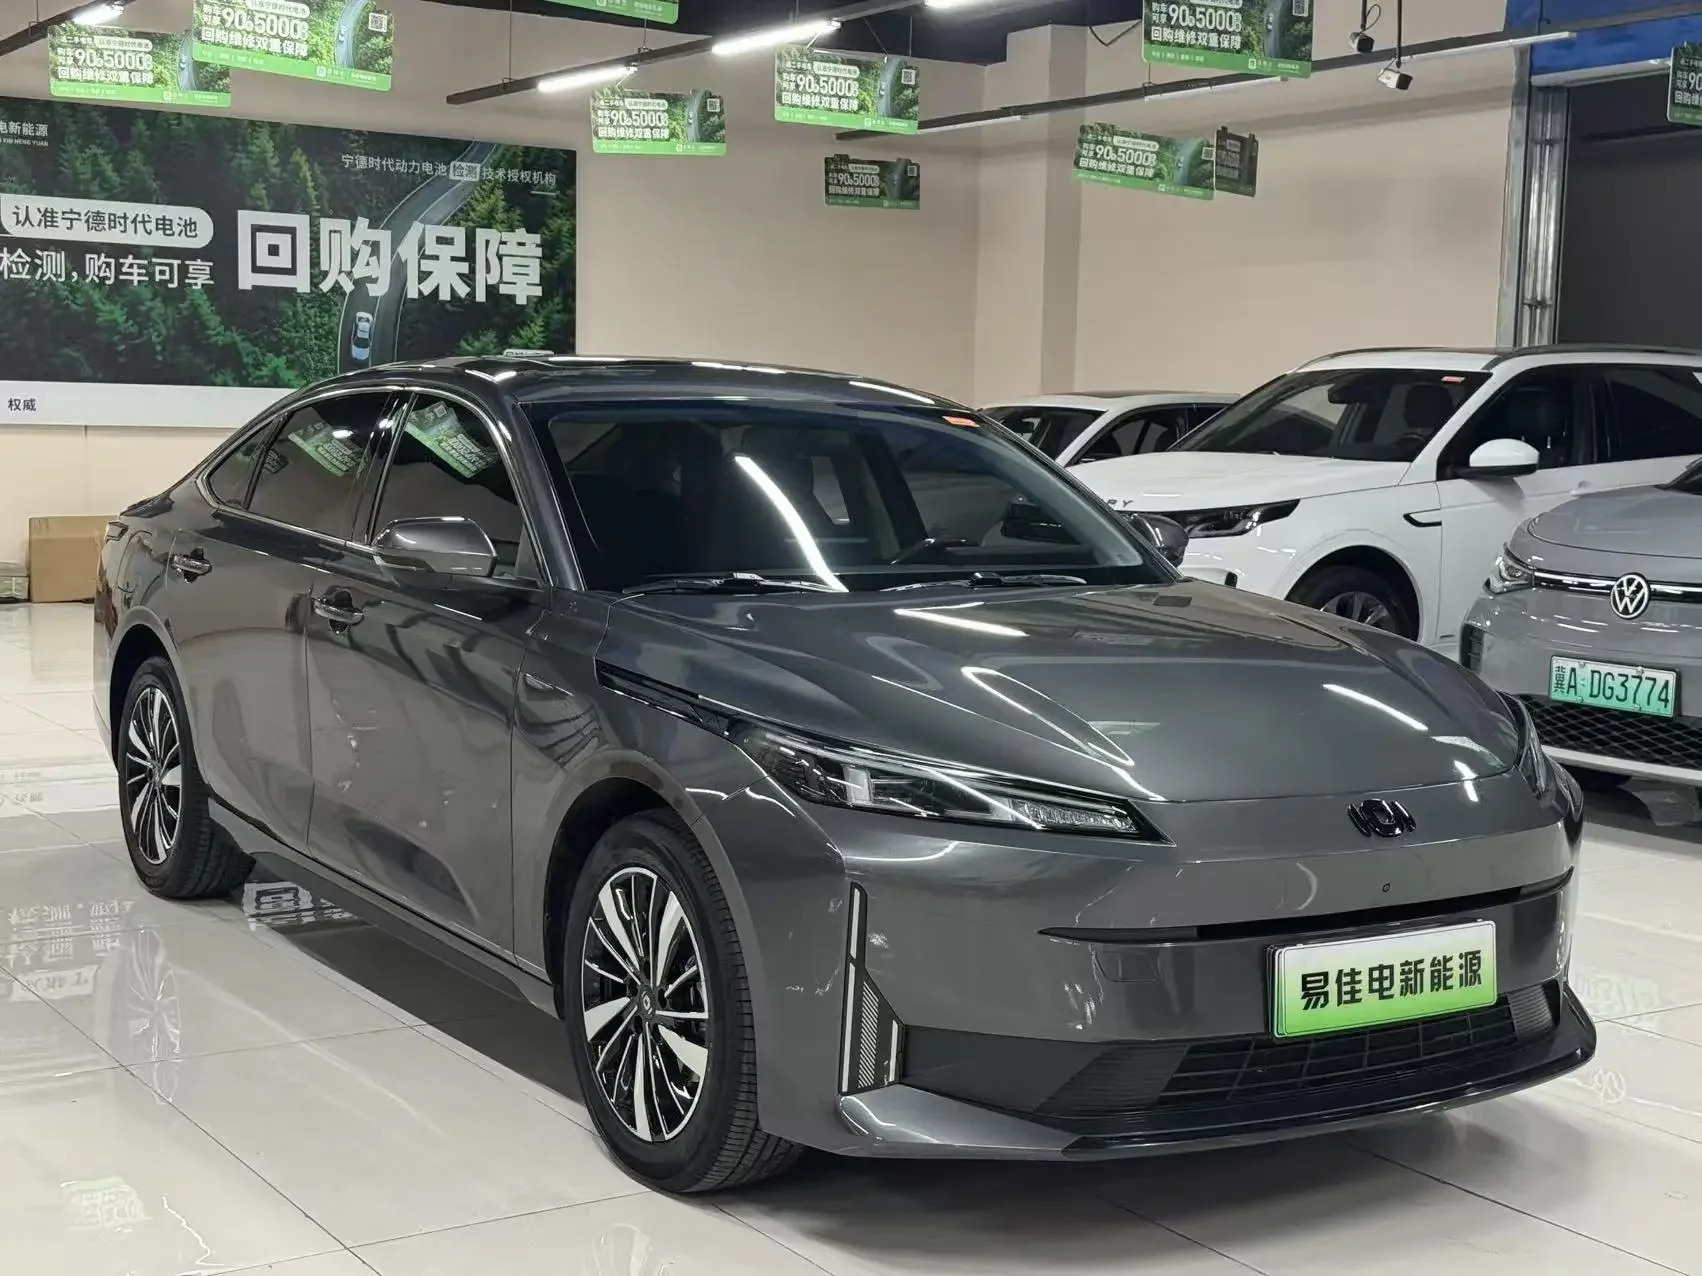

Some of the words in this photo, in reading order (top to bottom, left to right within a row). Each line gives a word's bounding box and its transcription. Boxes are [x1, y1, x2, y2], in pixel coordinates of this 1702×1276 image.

[201, 26, 309, 57] 回购维修双重保障
[1151, 26, 1242, 50] 回购维修双重保障
[58, 67, 153, 85] 回购维修双重保障
[782, 91, 859, 112] 回购维修双重保障
[1674, 90, 1702, 106] 回购维
[12, 204, 199, 239] 认准宁德时代电池
[237, 209, 543, 305] 回购保障
[7, 397, 37, 412] 权威
[1301, 949, 1482, 1011] 易佳电新能源
